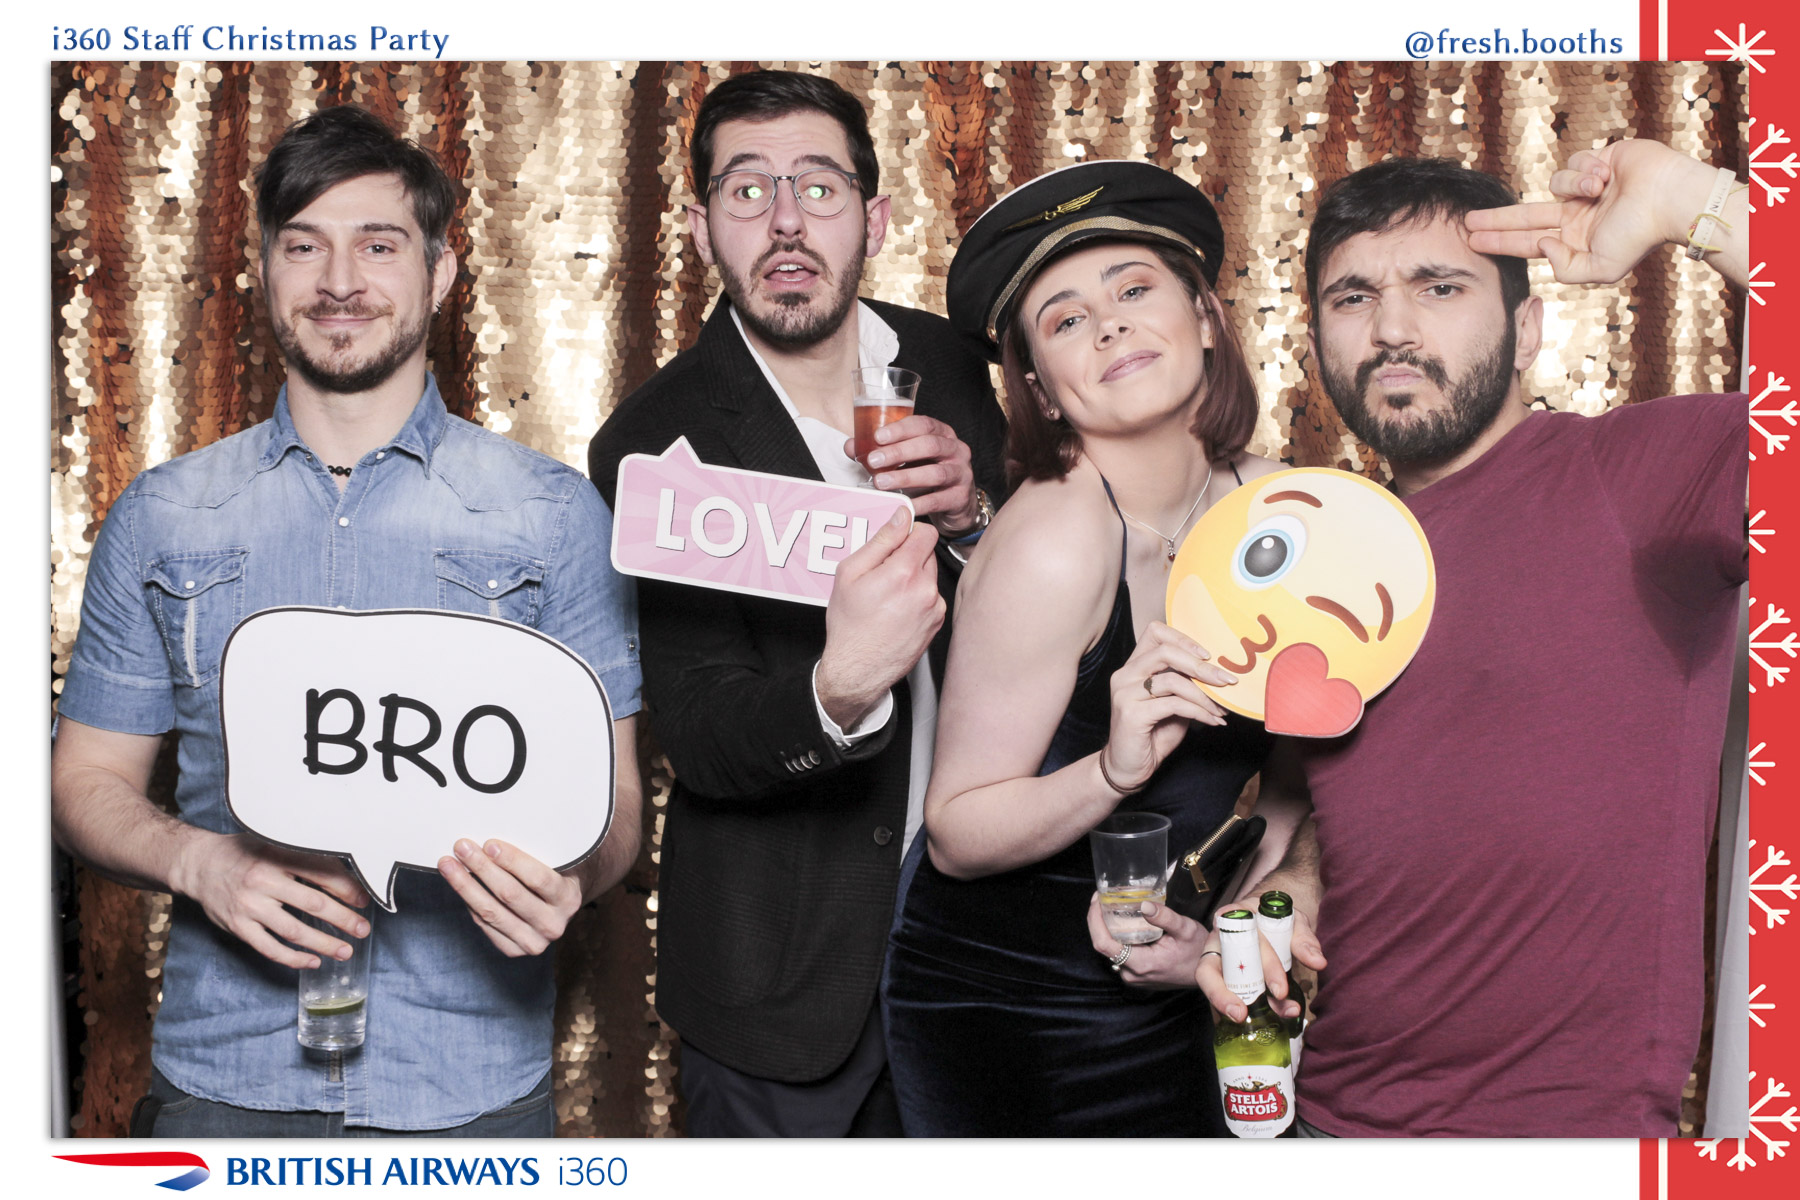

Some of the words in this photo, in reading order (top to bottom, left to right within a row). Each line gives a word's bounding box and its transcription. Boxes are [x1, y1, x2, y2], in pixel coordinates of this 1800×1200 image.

[303, 688, 527, 794] BRO
[1229, 1092, 1277, 1105] STELLA
[1231, 1102, 1278, 1115] ARTOIS
